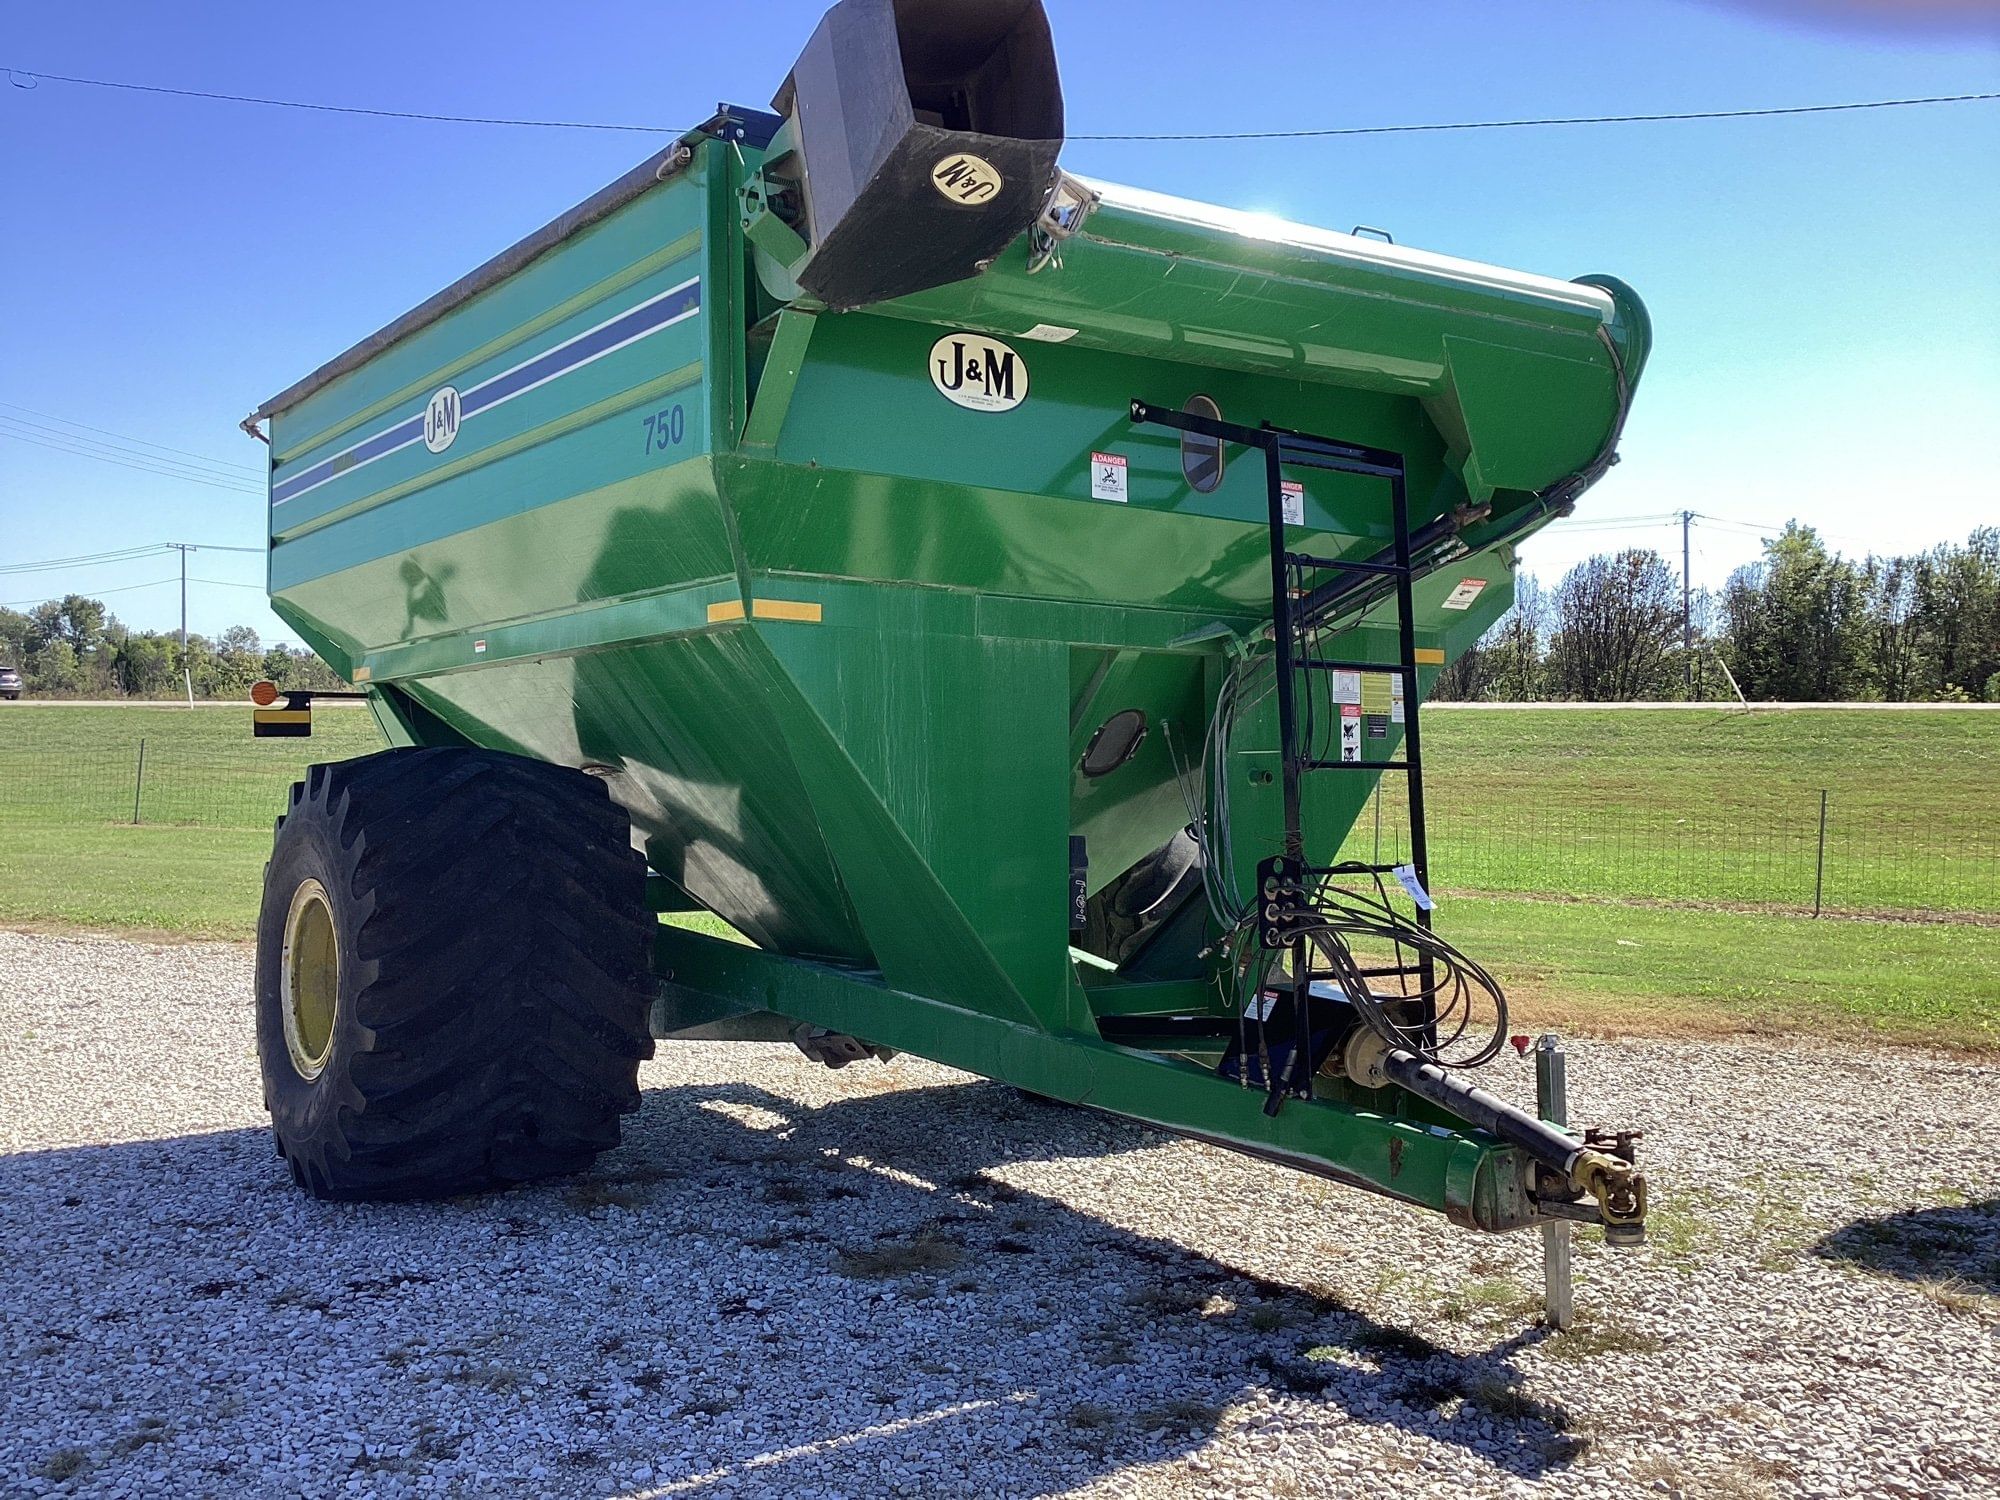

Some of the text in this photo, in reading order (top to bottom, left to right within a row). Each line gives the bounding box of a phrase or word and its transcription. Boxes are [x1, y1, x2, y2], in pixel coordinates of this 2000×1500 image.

[935, 157, 995, 200] J&M
[938, 341, 1016, 400] J&M
[427, 392, 456, 443] J&M
[643, 404, 684, 455] 750
[1098, 454, 1126, 466] DANGER
[1281, 481, 1303, 491] ANGER
